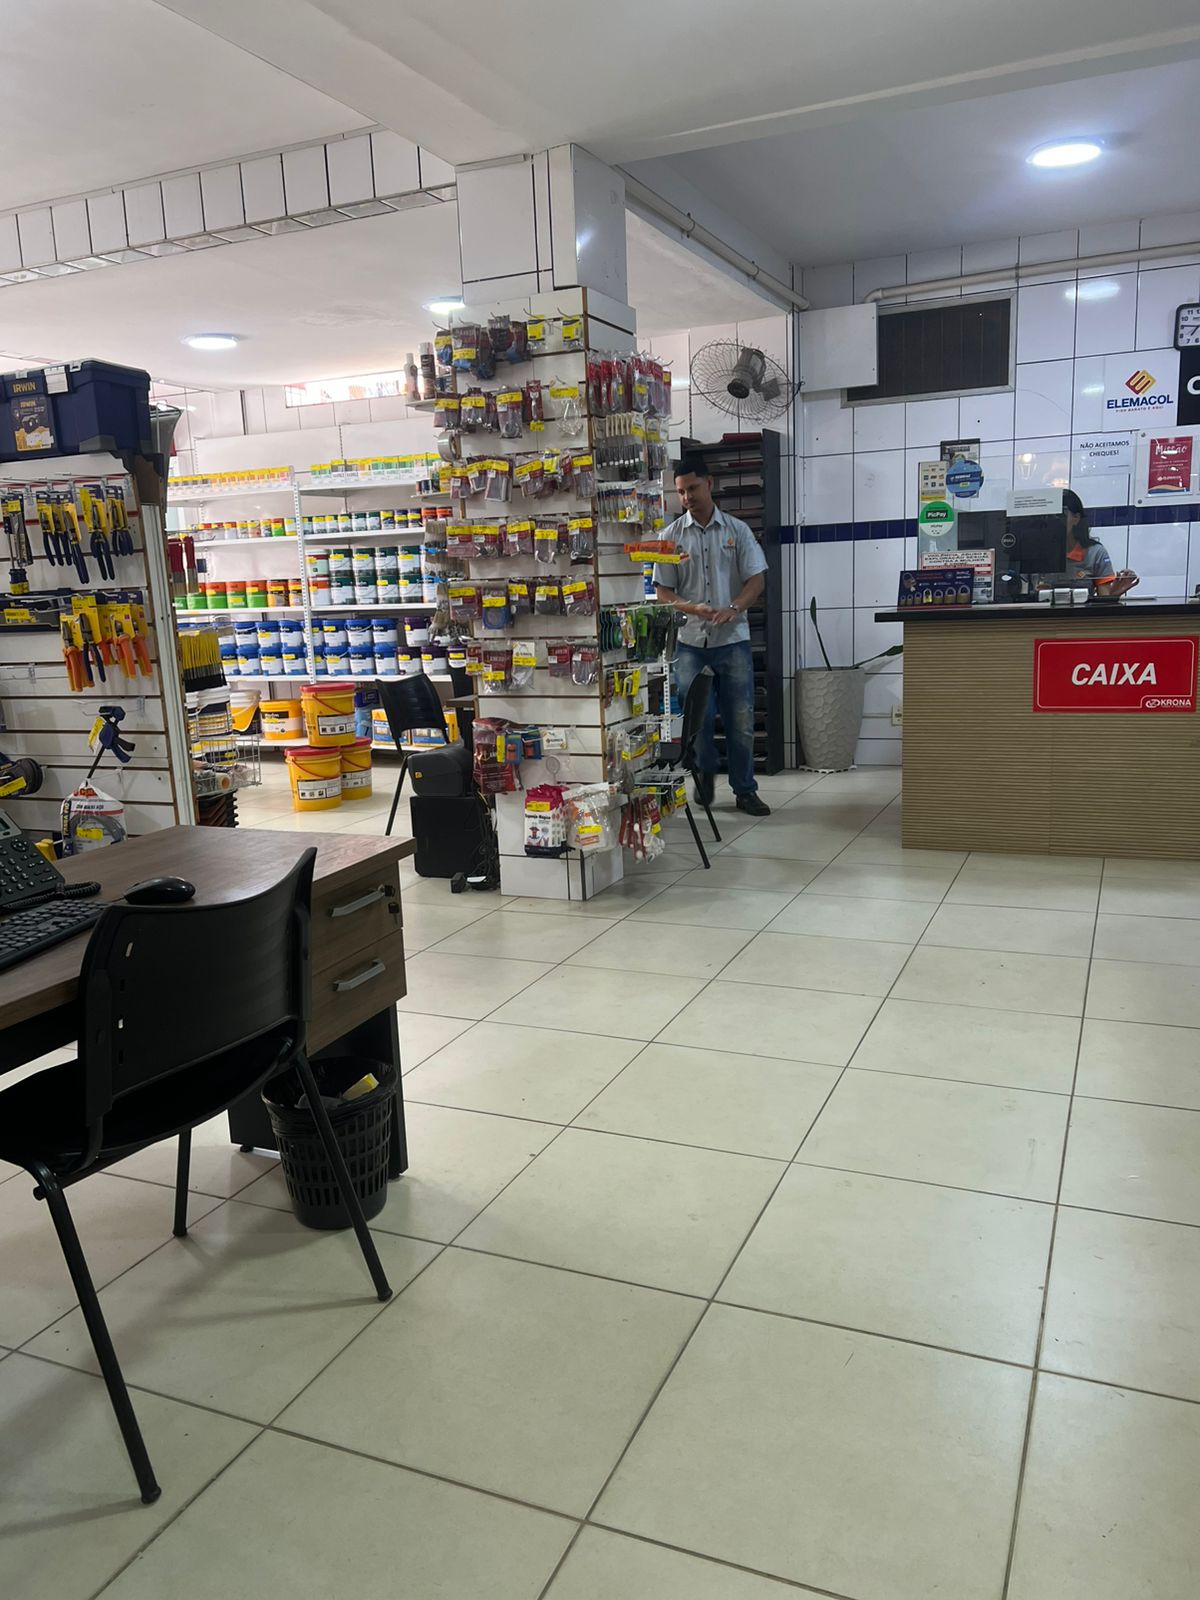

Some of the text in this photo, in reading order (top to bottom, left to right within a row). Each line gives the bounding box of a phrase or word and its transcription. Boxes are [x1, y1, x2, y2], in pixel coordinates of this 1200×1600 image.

[13, 382, 36, 393] IRWIN
[1107, 394, 1174, 409] ELEMACOL
[1079, 440, 1130, 449] NÃO ACEITAMOS
[1071, 662, 1157, 686] CAIXA
[1160, 698, 1192, 706] KRONA
